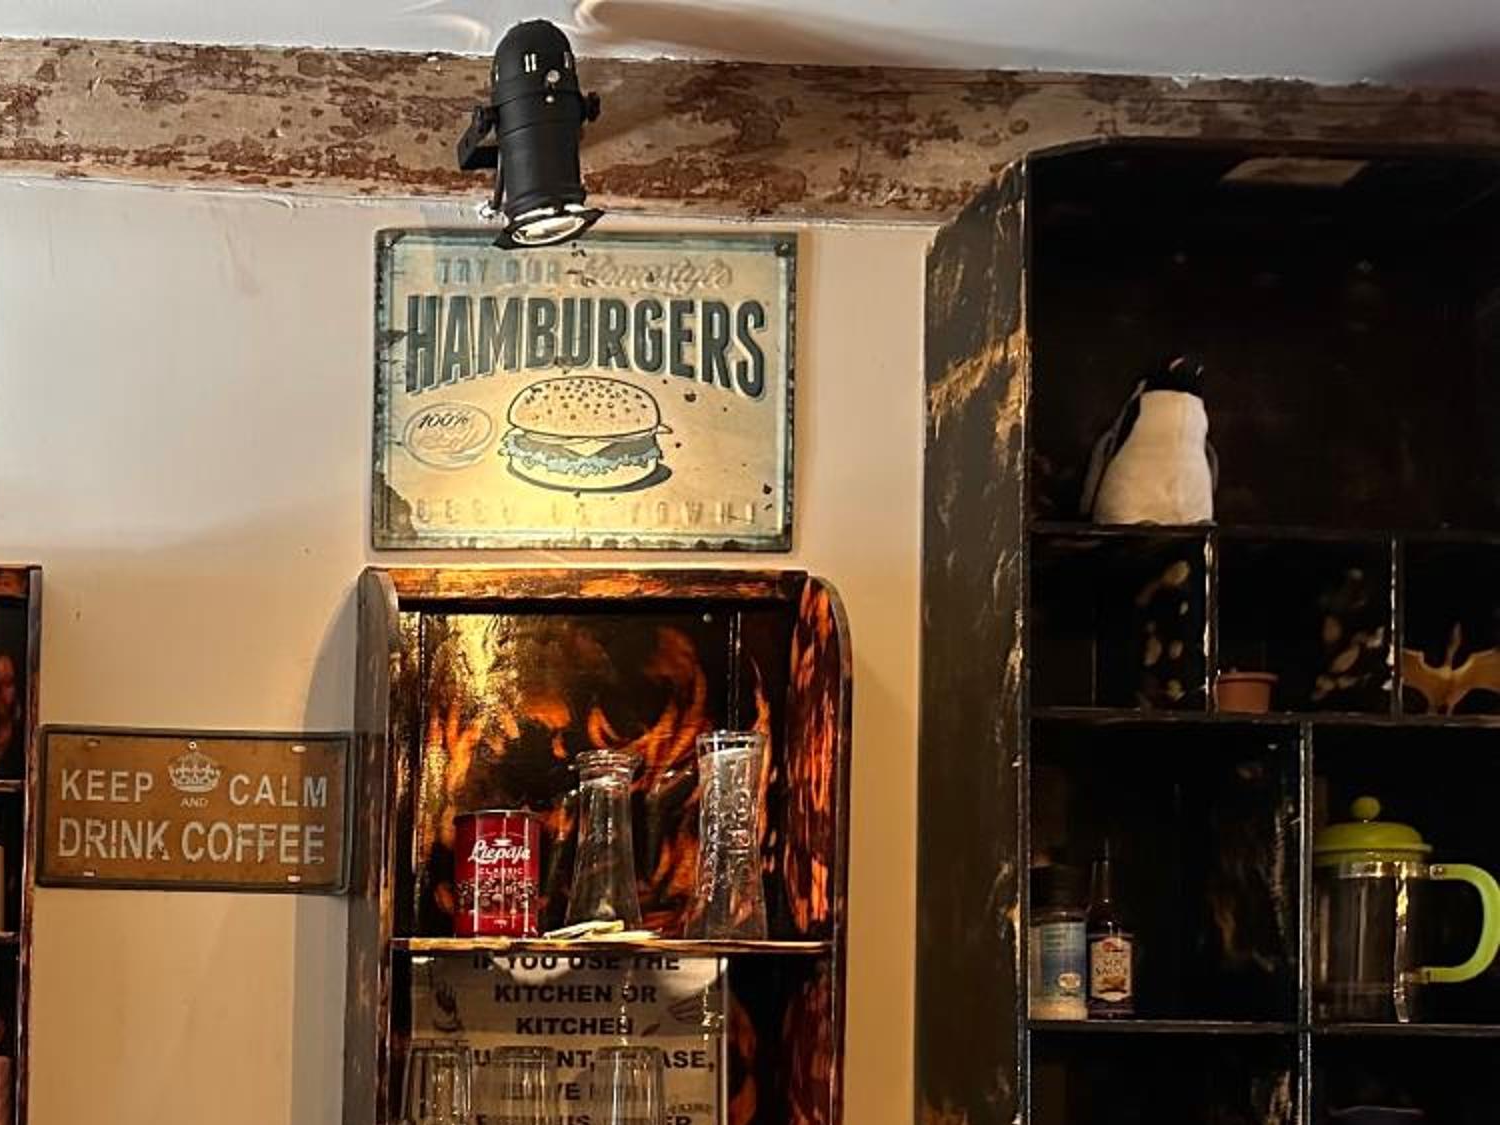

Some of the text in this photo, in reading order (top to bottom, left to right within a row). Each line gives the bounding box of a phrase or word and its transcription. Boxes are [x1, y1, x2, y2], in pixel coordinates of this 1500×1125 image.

[406, 294, 768, 400] HAMBURGERS
[60, 768, 327, 808] KEEP CALM
[180, 797, 208, 808] AND
[59, 817, 326, 865] DRINK COFFEE
[507, 955, 557, 970] YOU
[494, 985, 657, 1003] KITCHEN OR
[516, 1017, 632, 1036] KITCHEN
